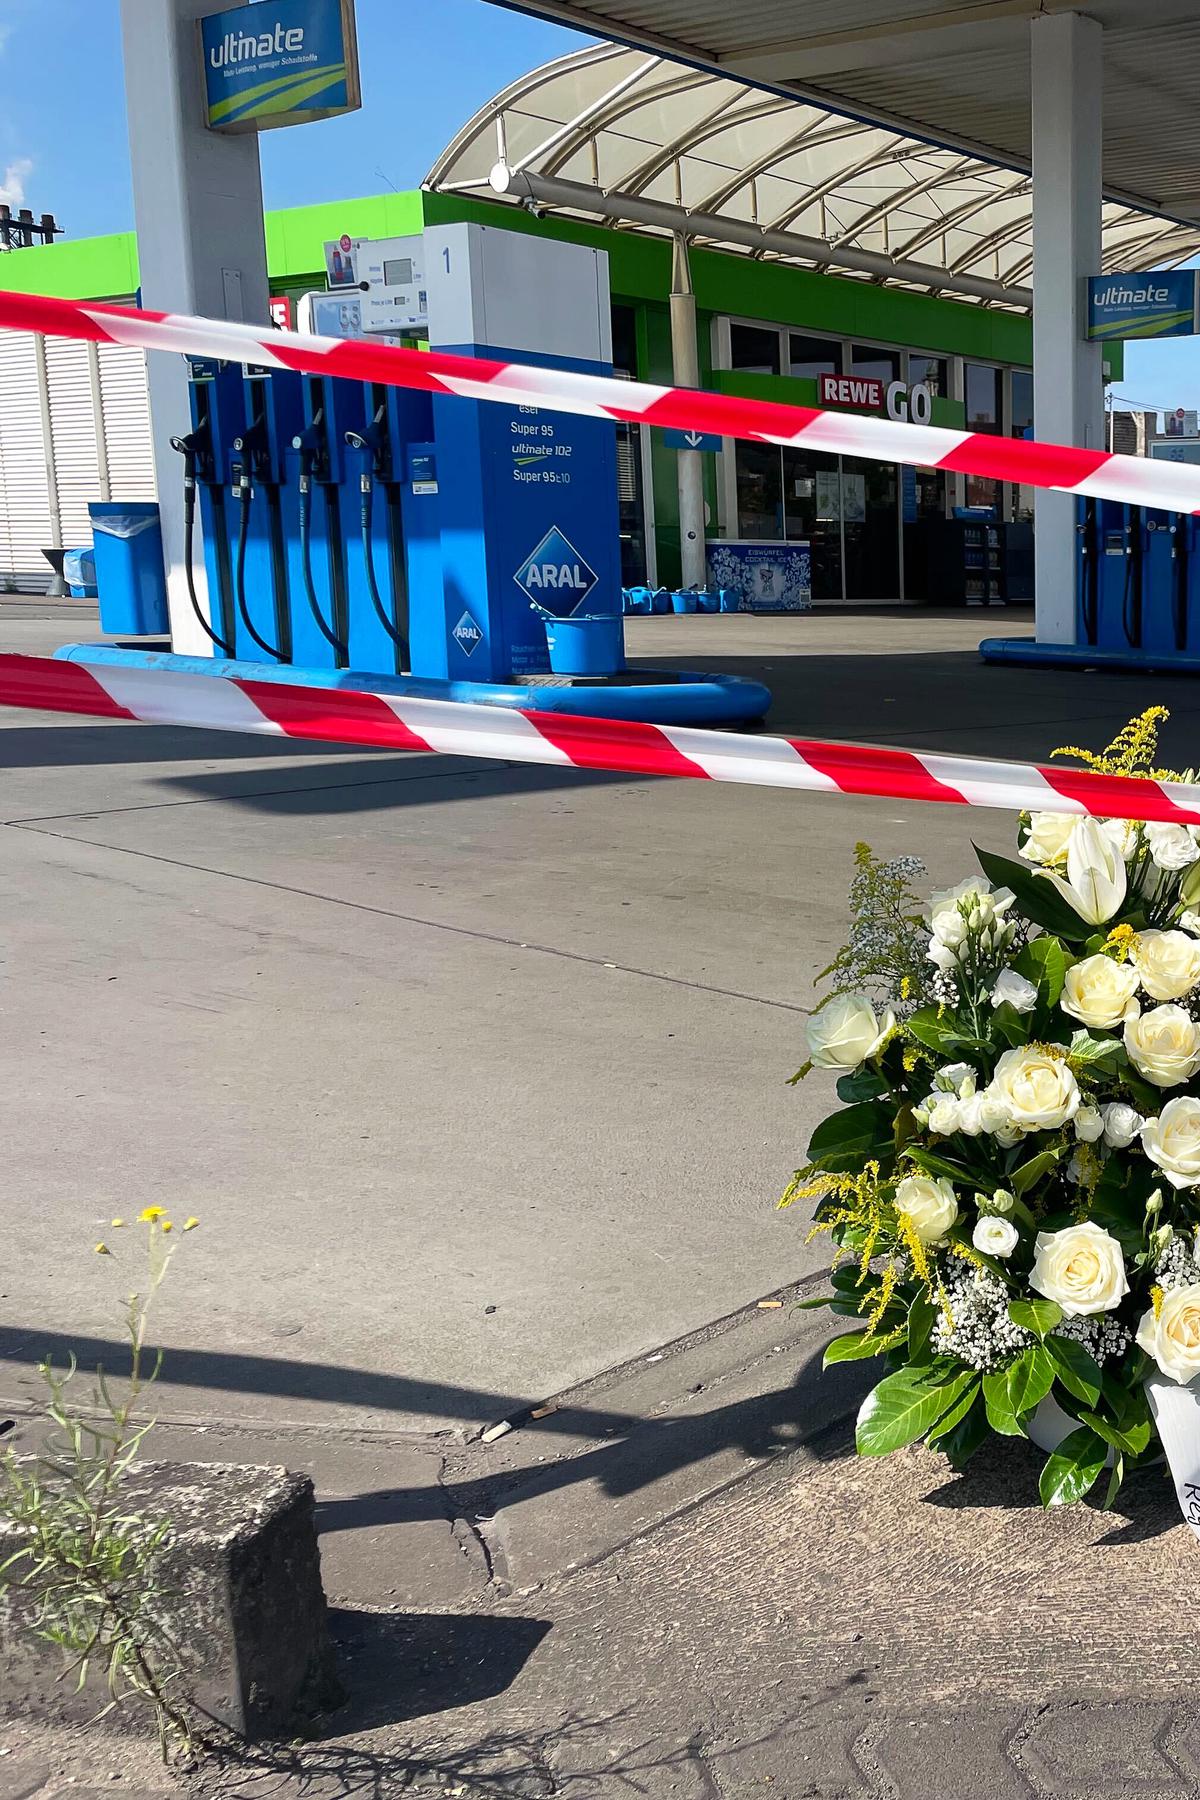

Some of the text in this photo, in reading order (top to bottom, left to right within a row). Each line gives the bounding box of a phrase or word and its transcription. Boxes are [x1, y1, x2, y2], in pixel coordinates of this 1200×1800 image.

[210, 22, 304, 69] ultimate
[442, 247, 450, 274] 1
[1093, 284, 1169, 306] ultimate
[824, 378, 931, 426] REWE GO
[510, 421, 554, 436] Super 95
[511, 443, 572, 456] ultimate 102
[513, 469, 541, 483] Super
[525, 563, 587, 588] ARAL
[456, 626, 479, 640] ARAL
